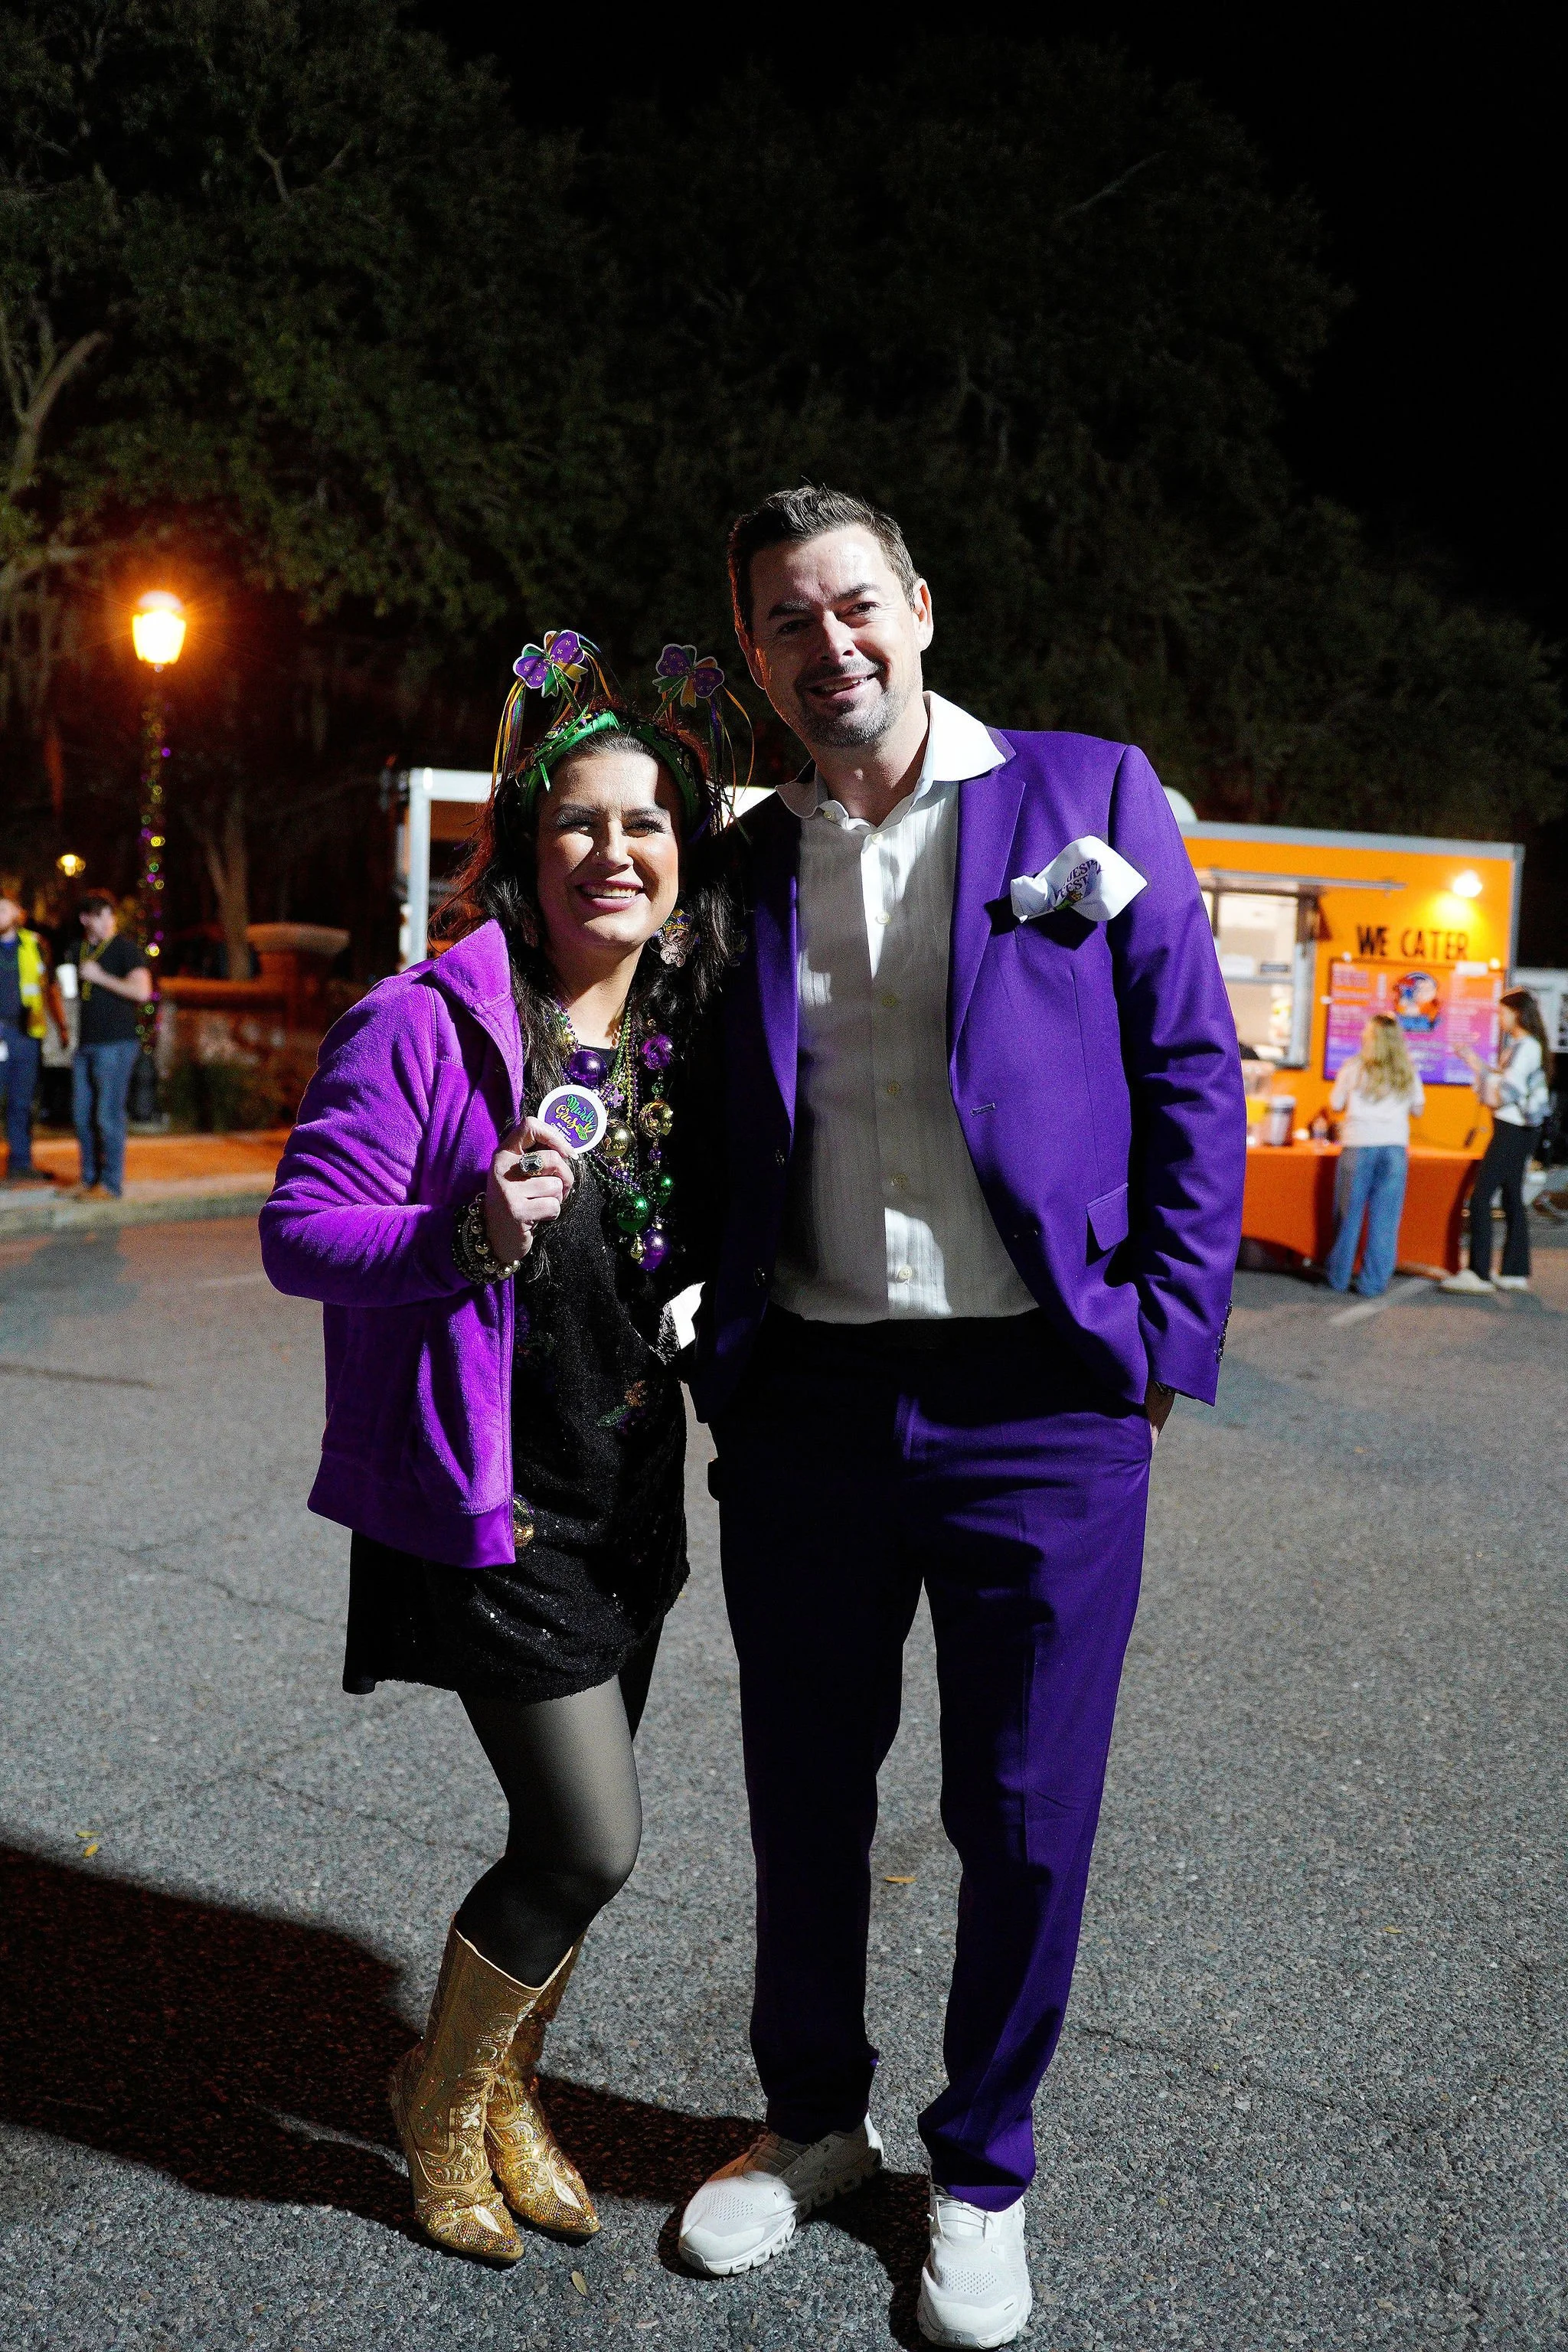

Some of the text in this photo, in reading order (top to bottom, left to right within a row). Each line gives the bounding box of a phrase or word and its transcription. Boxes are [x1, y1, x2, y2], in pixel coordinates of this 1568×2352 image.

[1357, 925, 1468, 960] WE CATER
[555, 1105, 578, 1129] Gras
[567, 1094, 595, 1123] Mardi
